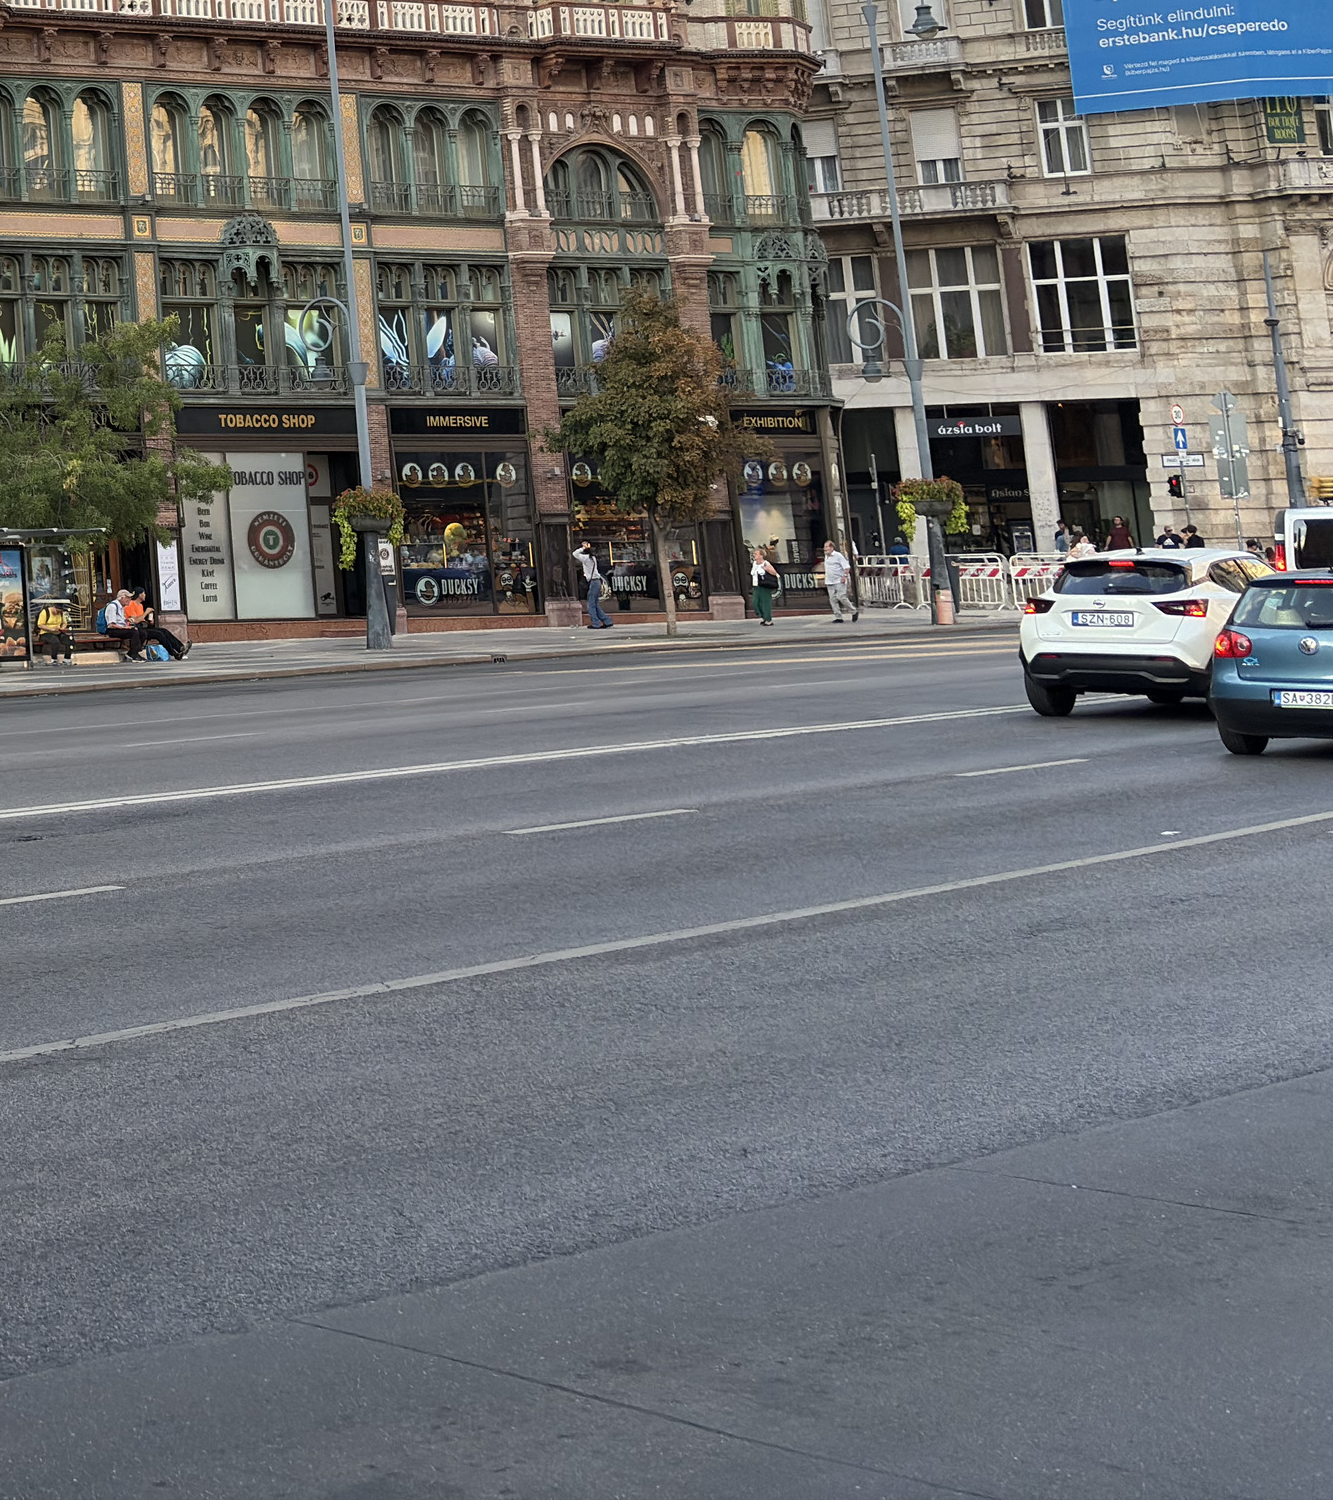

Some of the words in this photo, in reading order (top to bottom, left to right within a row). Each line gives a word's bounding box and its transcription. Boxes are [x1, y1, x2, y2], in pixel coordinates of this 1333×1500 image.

[1097, 12, 1163, 32] Segítünk
[1168, 3, 1236, 22] elindulni:
[1099, 18, 1288, 48] erstebank.hu/cseperedo
[218, 414, 278, 428] TOBACCO
[282, 414, 316, 428] SHOP
[426, 415, 489, 427] IMMERSIVE
[1173, 410, 1182, 419] 30
[743, 416, 803, 428] EXHIBITION
[937, 422, 973, 435] ázsia
[975, 423, 1002, 434] bolt
[278, 470, 305, 485] SHOP
[266, 535, 277, 546] T
[441, 578, 479, 595] DUCKSY
[611, 575, 647, 592] DUCKSY
[784, 573, 819, 589] DUCKSY
[1081, 613, 1131, 626] SZN-608
[1305, 693, 1333, 705] 382
